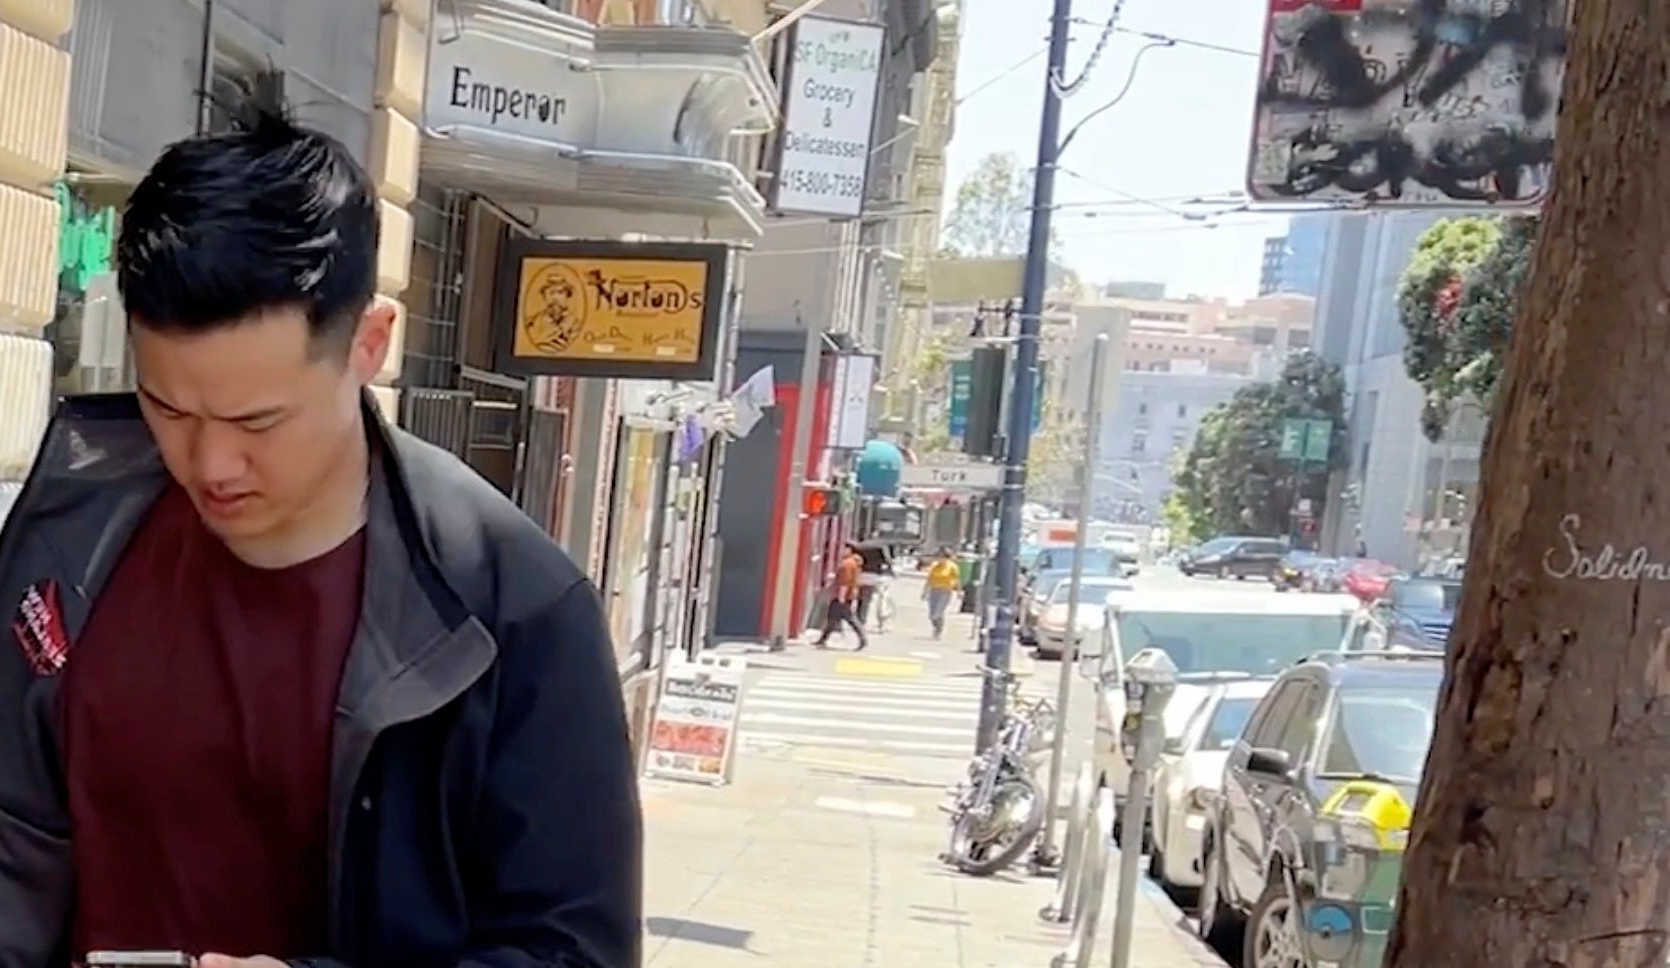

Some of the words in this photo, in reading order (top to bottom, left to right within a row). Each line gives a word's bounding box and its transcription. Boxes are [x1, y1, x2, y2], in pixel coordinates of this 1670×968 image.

[450, 65, 567, 125] Emperor
[803, 77, 856, 109] Grocery
[785, 131, 866, 159] Delicatessen
[931, 468, 967, 482] Turk
